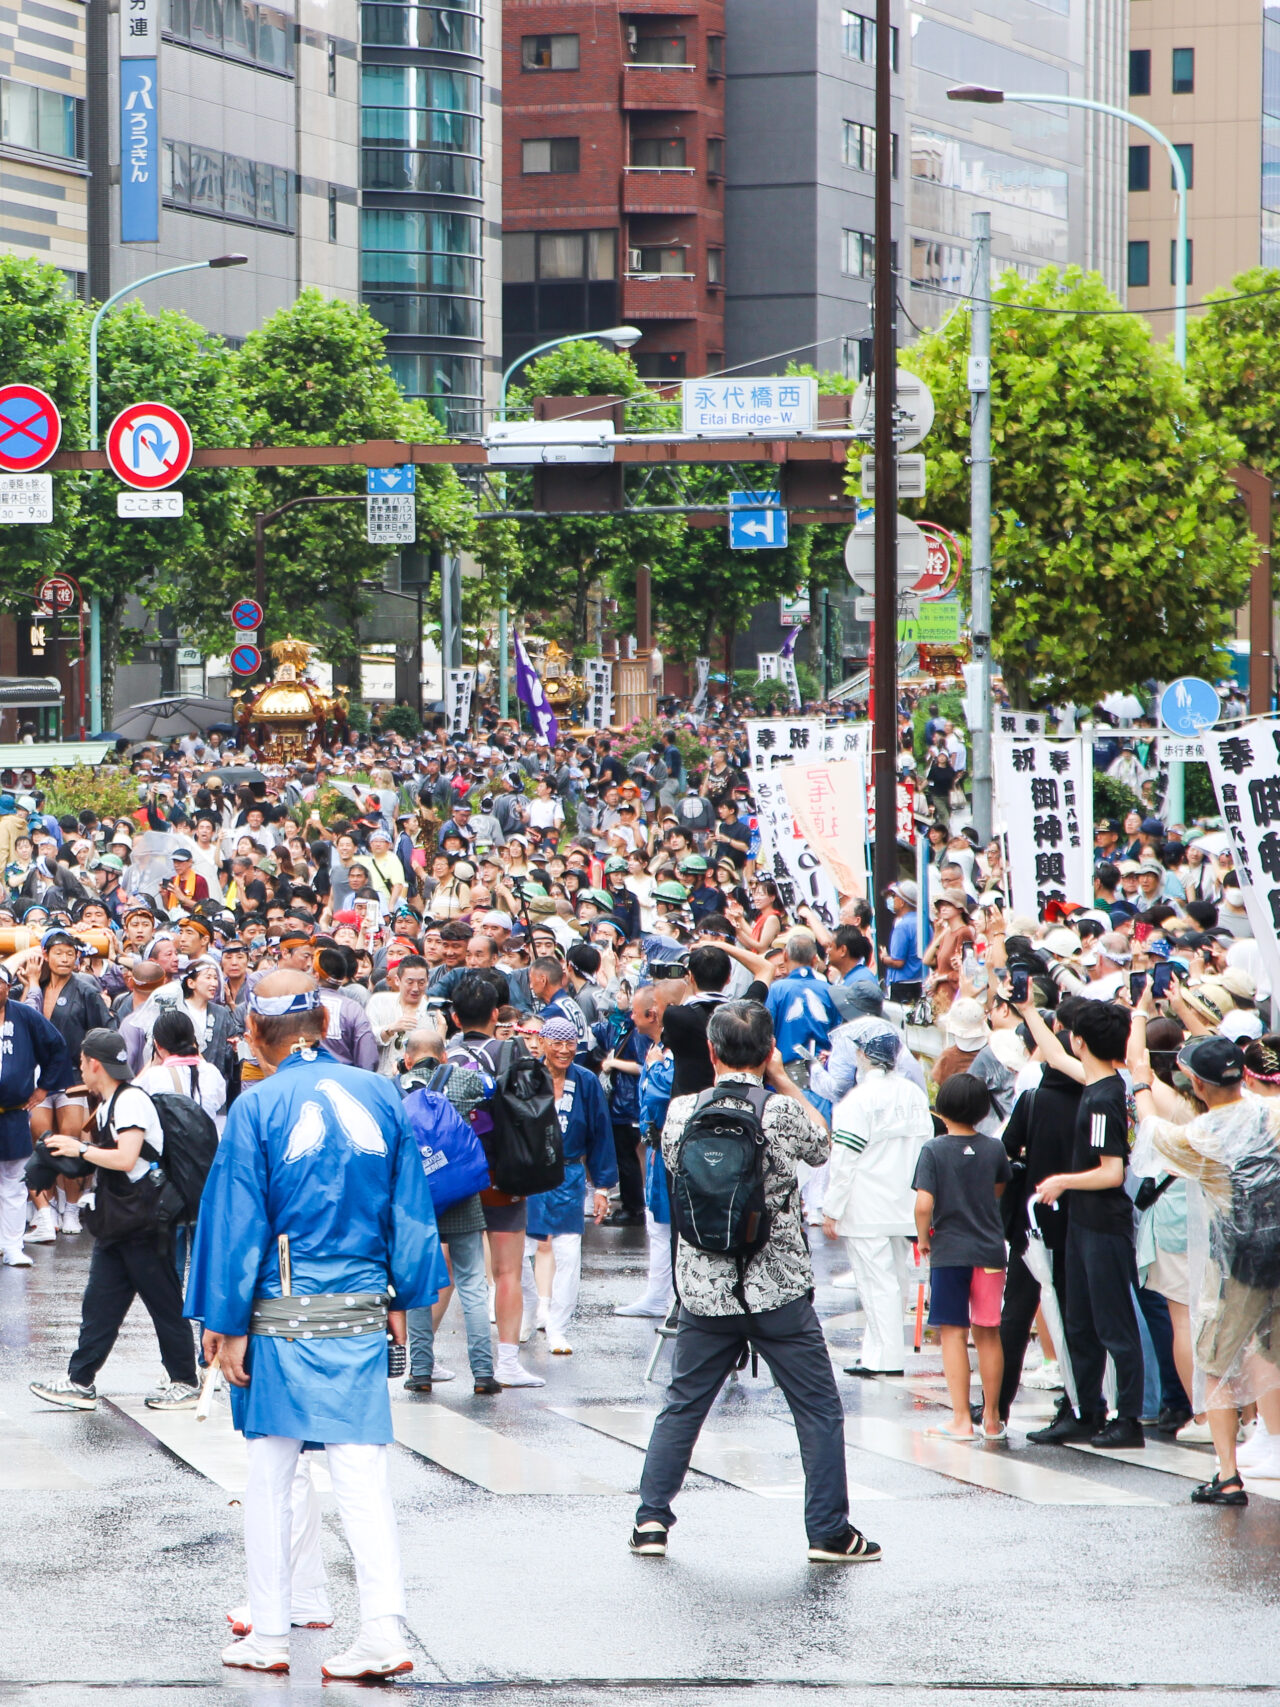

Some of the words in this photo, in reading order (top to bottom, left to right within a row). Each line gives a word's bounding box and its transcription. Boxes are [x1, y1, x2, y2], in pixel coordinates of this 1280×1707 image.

[130, 112, 149, 183] ろうきん
[694, 386, 801, 409] 永代橋西
[700, 413, 727, 425] Eitai
[124, 498, 178, 512] ここまで
[1063, 779, 1081, 848] 富岡八幡宮
